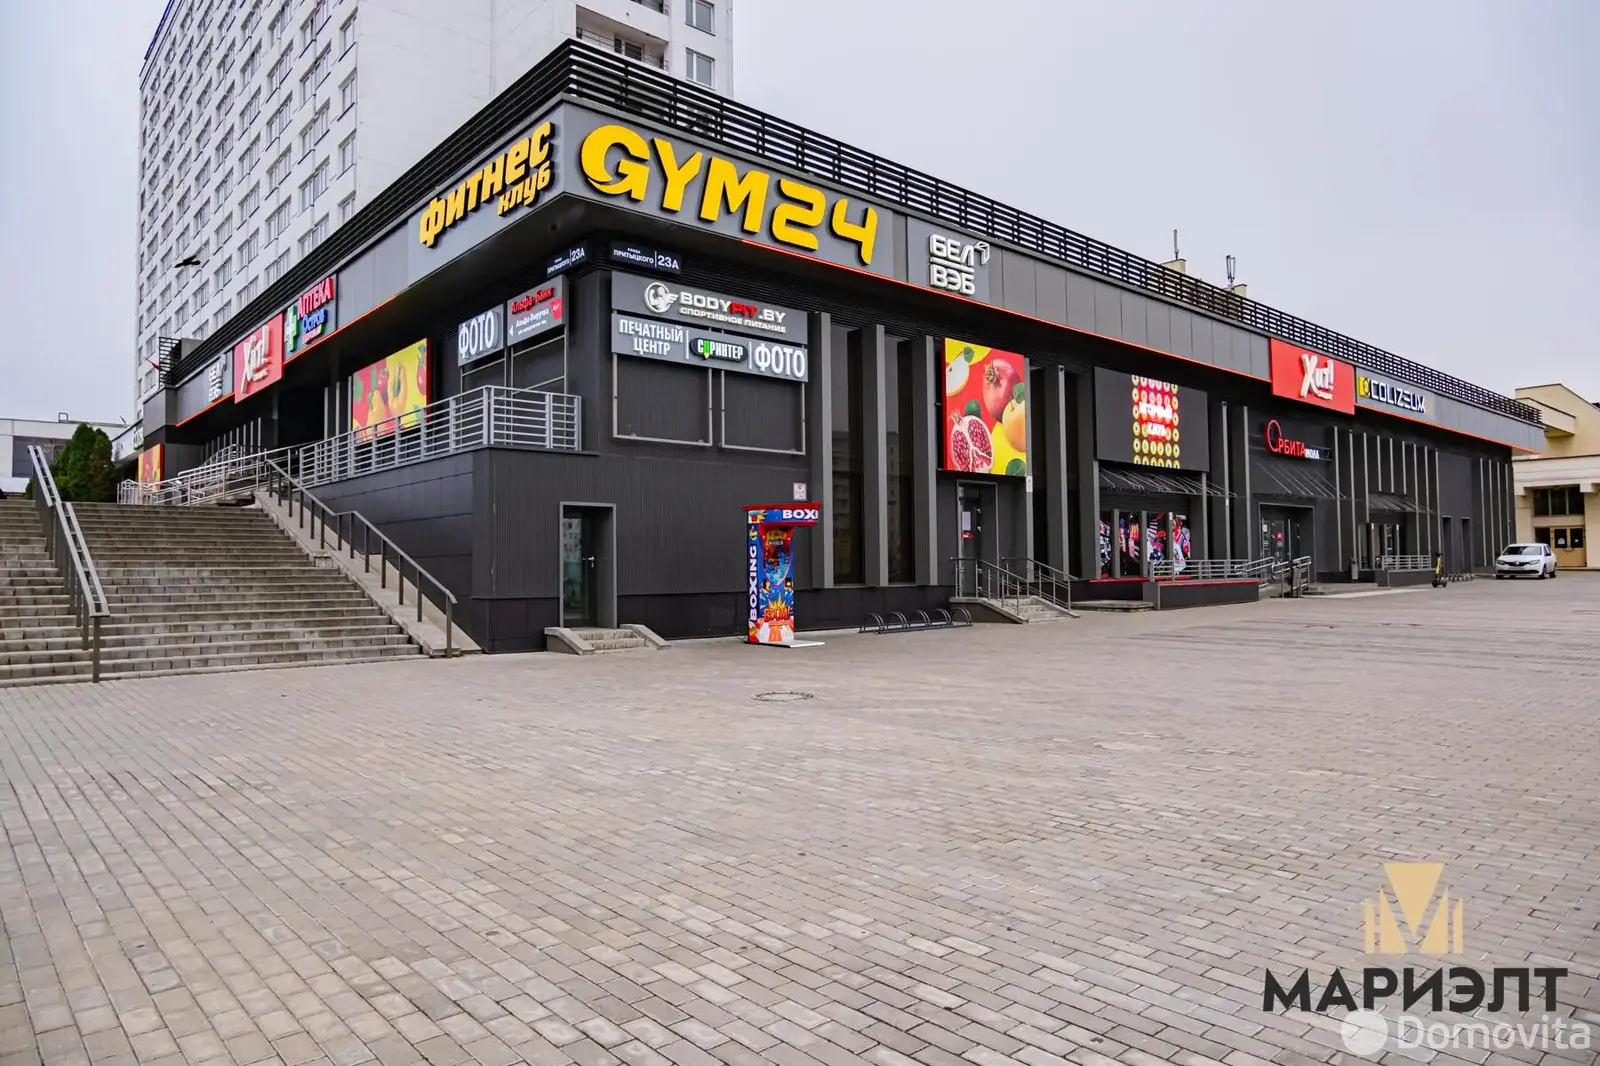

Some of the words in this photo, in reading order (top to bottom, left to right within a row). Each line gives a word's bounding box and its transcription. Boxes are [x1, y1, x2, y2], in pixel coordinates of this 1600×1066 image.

[580, 124, 878, 265] GYM24
[613, 249, 654, 264] ПРИТЫЦКОГО
[929, 234, 975, 267] БЕЛ
[929, 264, 976, 295] ВЭБ
[298, 277, 334, 320] АПТЕКА
[459, 310, 497, 359] ФОТО
[679, 307, 743, 326] СПОРТИВНОЕ
[744, 318, 787, 334] ПИТАНИЕ
[618, 319, 684, 344] ПЕЧАТНЫЙ
[697, 338, 744, 361] СПРИНТЕР
[754, 343, 806, 378] ФОТО
[632, 336, 671, 357] ЦЕНТР
[1370, 379, 1426, 413] COLIZEUM
[749, 545, 758, 621] BOXING
